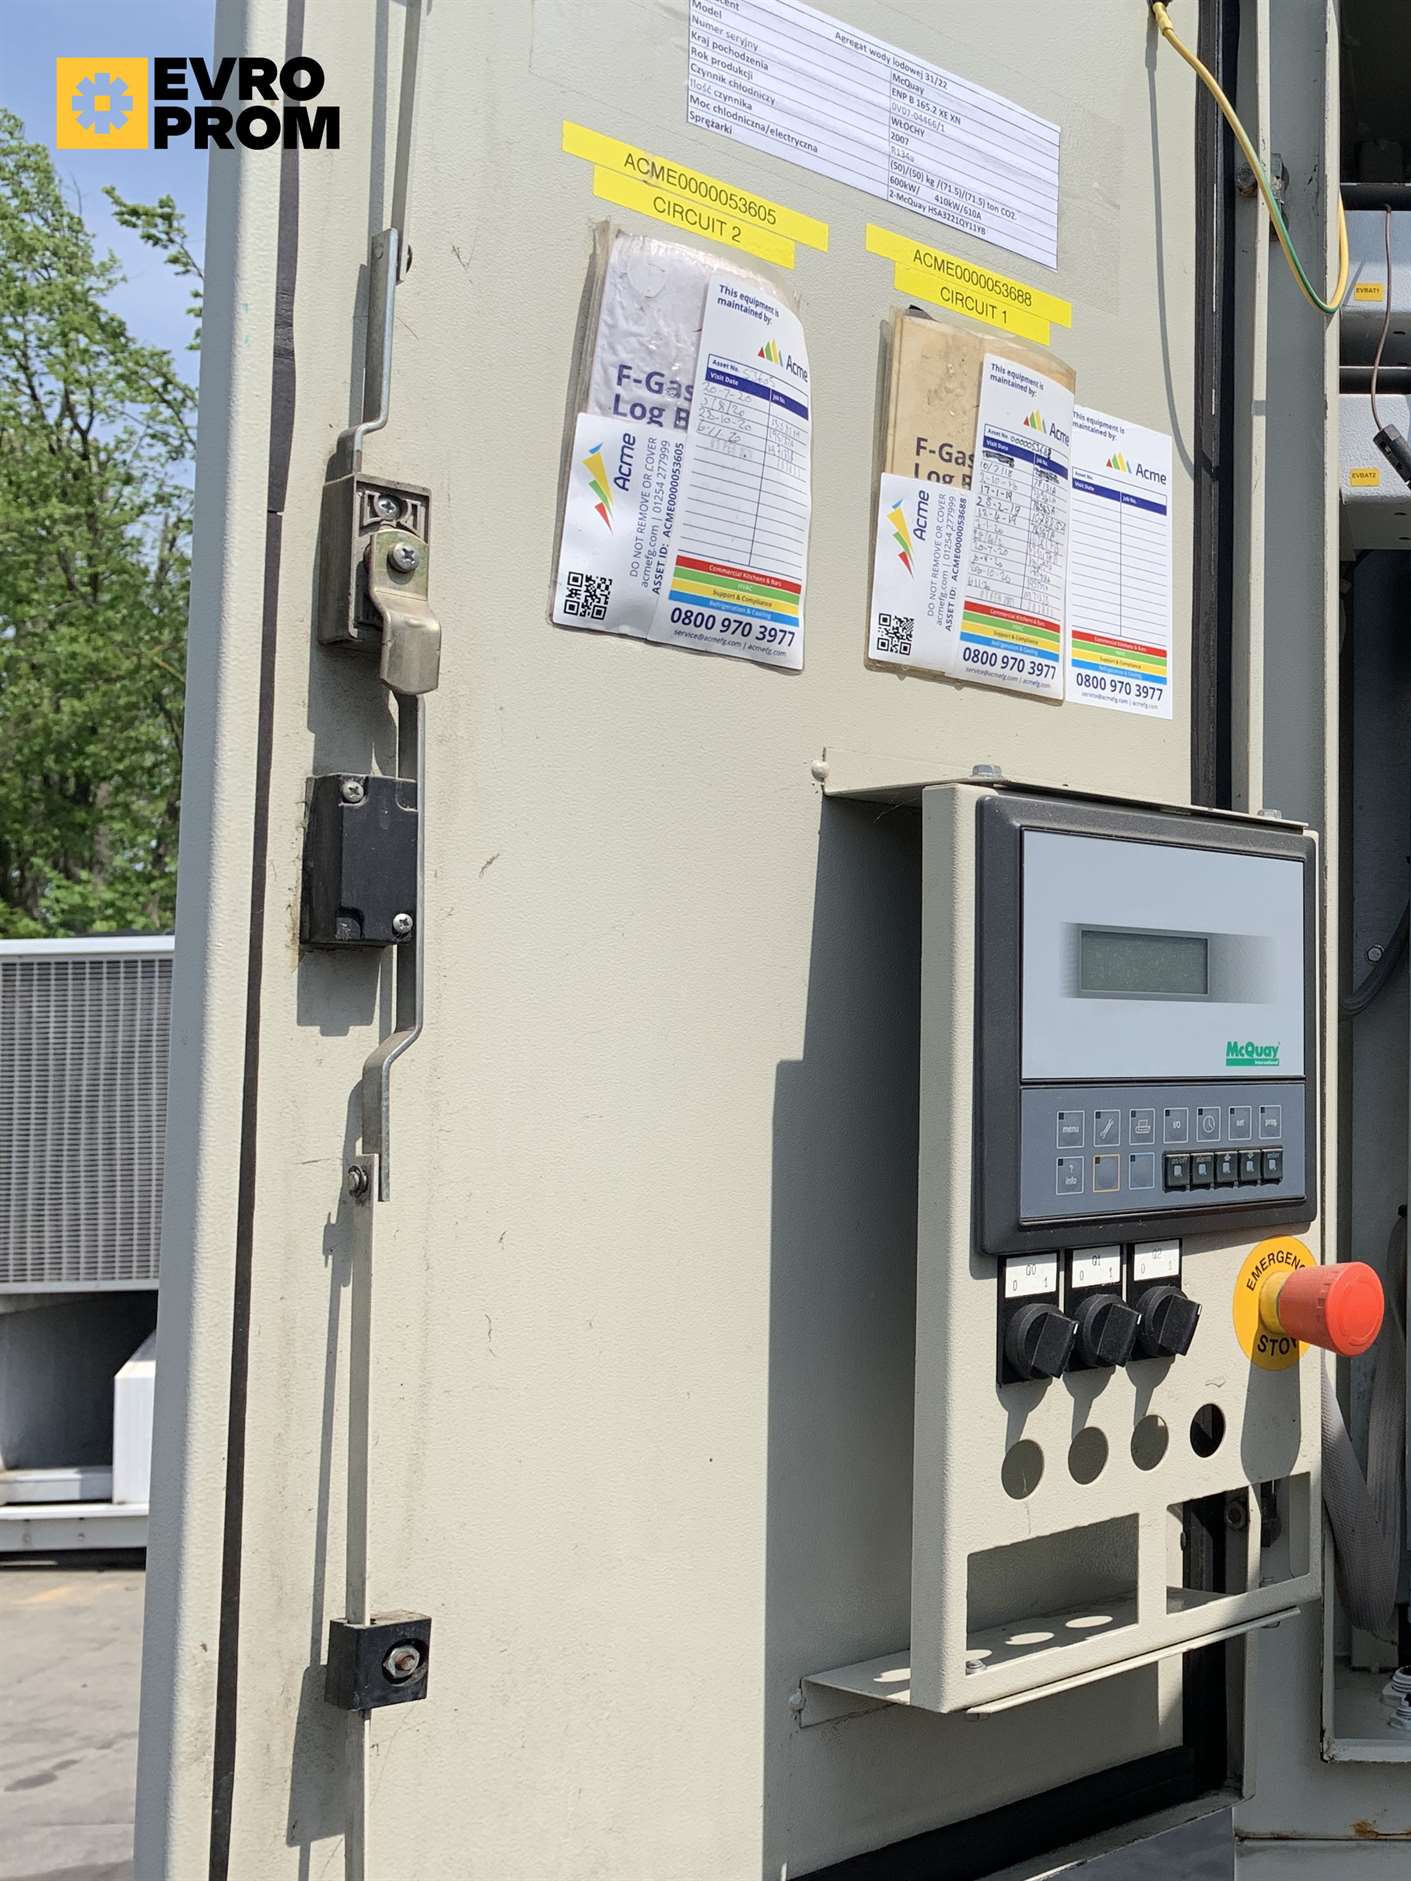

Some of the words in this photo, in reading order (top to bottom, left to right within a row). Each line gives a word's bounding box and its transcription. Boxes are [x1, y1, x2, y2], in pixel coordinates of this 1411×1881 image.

[691, 1, 722, 19] Model
[691, 15, 723, 35] Numer
[726, 30, 759, 52] seryjny
[691, 30, 710, 46] Kraj
[712, 42, 769, 71] pochodzenia
[691, 47, 709, 62] Rok
[711, 57, 753, 80] produkcji
[835, 31, 867, 53] Agregat
[869, 48, 891, 65] wody
[892, 55, 924, 79] lodowej
[925, 70, 948, 90] 31/22
[690, 63, 726, 83] Czynnik
[892, 72, 925, 95] McQuay
[689, 94, 710, 111] Moc
[713, 90, 753, 111] czynnika
[891, 87, 908, 102] ENP
[916, 99, 938, 115] 165.2
[689, 110, 733, 136] Sprężarki
[890, 131, 910, 146] 2007
[889, 175, 920, 196] 600kW/
[890, 160, 925, 182] (50)/(50)
[926, 174, 935, 188] kg
[624, 152, 777, 226] ACME0000053605
[889, 189, 927, 213] 2-McQuay
[652, 195, 728, 237] CIRCUIT
[731, 225, 742, 244] 2
[912, 248, 1033, 308] ACME0000053688
[717, 296, 762, 321] maintained
[719, 284, 739, 299] This
[739, 292, 775, 316] equipment
[939, 286, 998, 320] CIRCUIT
[1001, 310, 1008, 325] 1
[616, 363, 694, 402] F-Gas
[710, 371, 725, 382] Visit
[725, 376, 739, 387] Date
[785, 354, 809, 384] Acme
[991, 362, 1006, 377] This
[1007, 369, 1038, 389] equipment
[989, 373, 1028, 394] maintained
[612, 393, 667, 428] Log
[1072, 411, 1085, 421] This
[1086, 415, 1118, 430] equipment
[1049, 422, 1070, 447] Acme
[1072, 420, 1107, 437] maintained
[613, 432, 637, 492] Acme
[645, 436, 658, 473] COVER
[658, 440, 671, 480] 277999
[915, 436, 975, 469] F-Gas
[642, 474, 653, 491] OR
[1135, 463, 1167, 485] Acme
[653, 482, 665, 514] 01254
[662, 442, 685, 538] ACME0000053605
[637, 493, 650, 534] REMOVE
[913, 490, 930, 541] Acme
[937, 493, 946, 523] COVER
[936, 524, 944, 539] OR
[633, 535, 645, 558] NOT
[641, 524, 659, 588] acmefg.com
[661, 542, 670, 555] ID:
[933, 540, 943, 579] REMOVE
[629, 560, 640, 577] DO
[652, 557, 665, 596] ASSET
[929, 578, 938, 600] NOT
[927, 601, 935, 617] DO
[945, 596, 955, 632] ASSET
[670, 606, 716, 631] 0800
[719, 617, 752, 638] 970
[755, 624, 796, 648] 3977
[962, 646, 998, 667] 0800
[1001, 655, 1025, 673] 970
[1027, 660, 1056, 680] 3977
[1076, 672, 1106, 692] 0800
[1109, 679, 1132, 696] 970
[1134, 683, 1163, 701] 3977
[1226, 1041, 1280, 1058] McQuay
[1079, 1269, 1085, 1281] 0
[1140, 1263, 1146, 1274] 0
[1246, 1250, 1306, 1292] EMERGEN
[1012, 1279, 1018, 1291] 0
